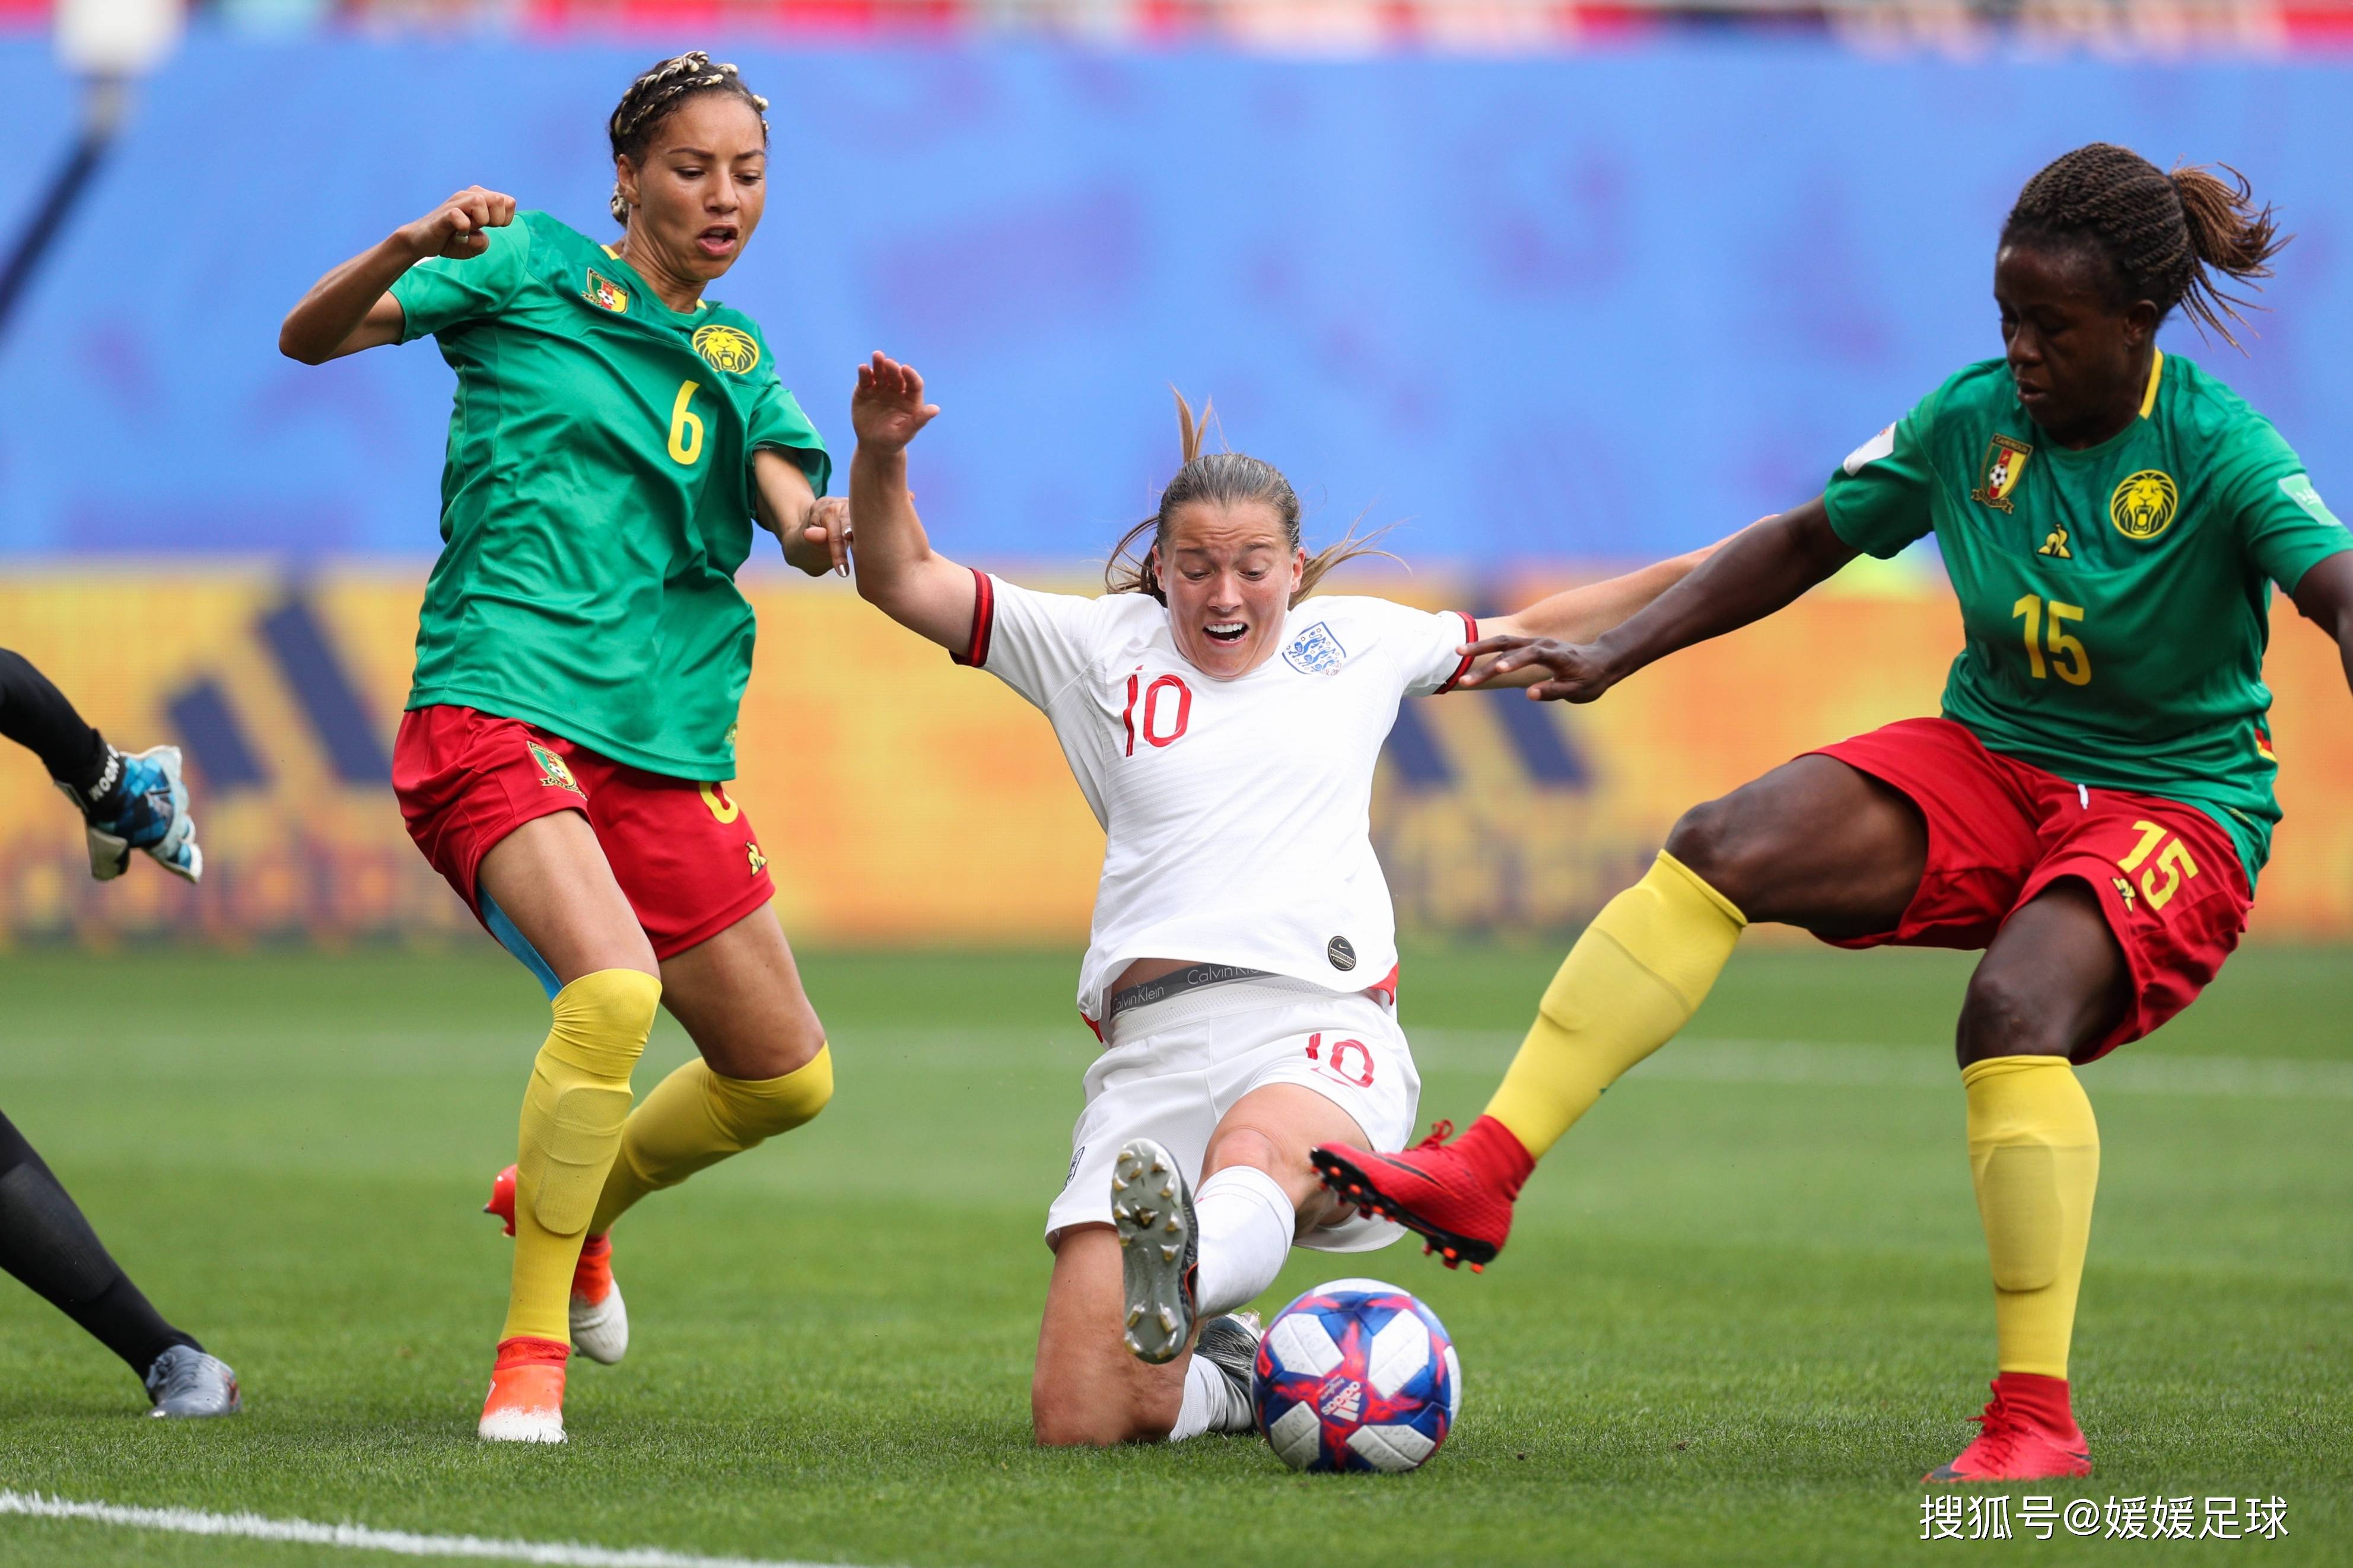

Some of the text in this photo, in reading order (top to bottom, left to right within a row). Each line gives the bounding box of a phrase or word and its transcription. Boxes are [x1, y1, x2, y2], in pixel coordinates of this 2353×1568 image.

[668, 380, 704, 465] 6
[2013, 594, 2091, 686] 15
[1123, 664, 1192, 758] 10
[2117, 820, 2199, 911] 15
[1112, 983, 1164, 1013] Calvin Klein
[1187, 965, 1233, 985] Calvin
[1305, 1032, 1374, 1088] 10
[1321, 1381, 1361, 1416] adidas
